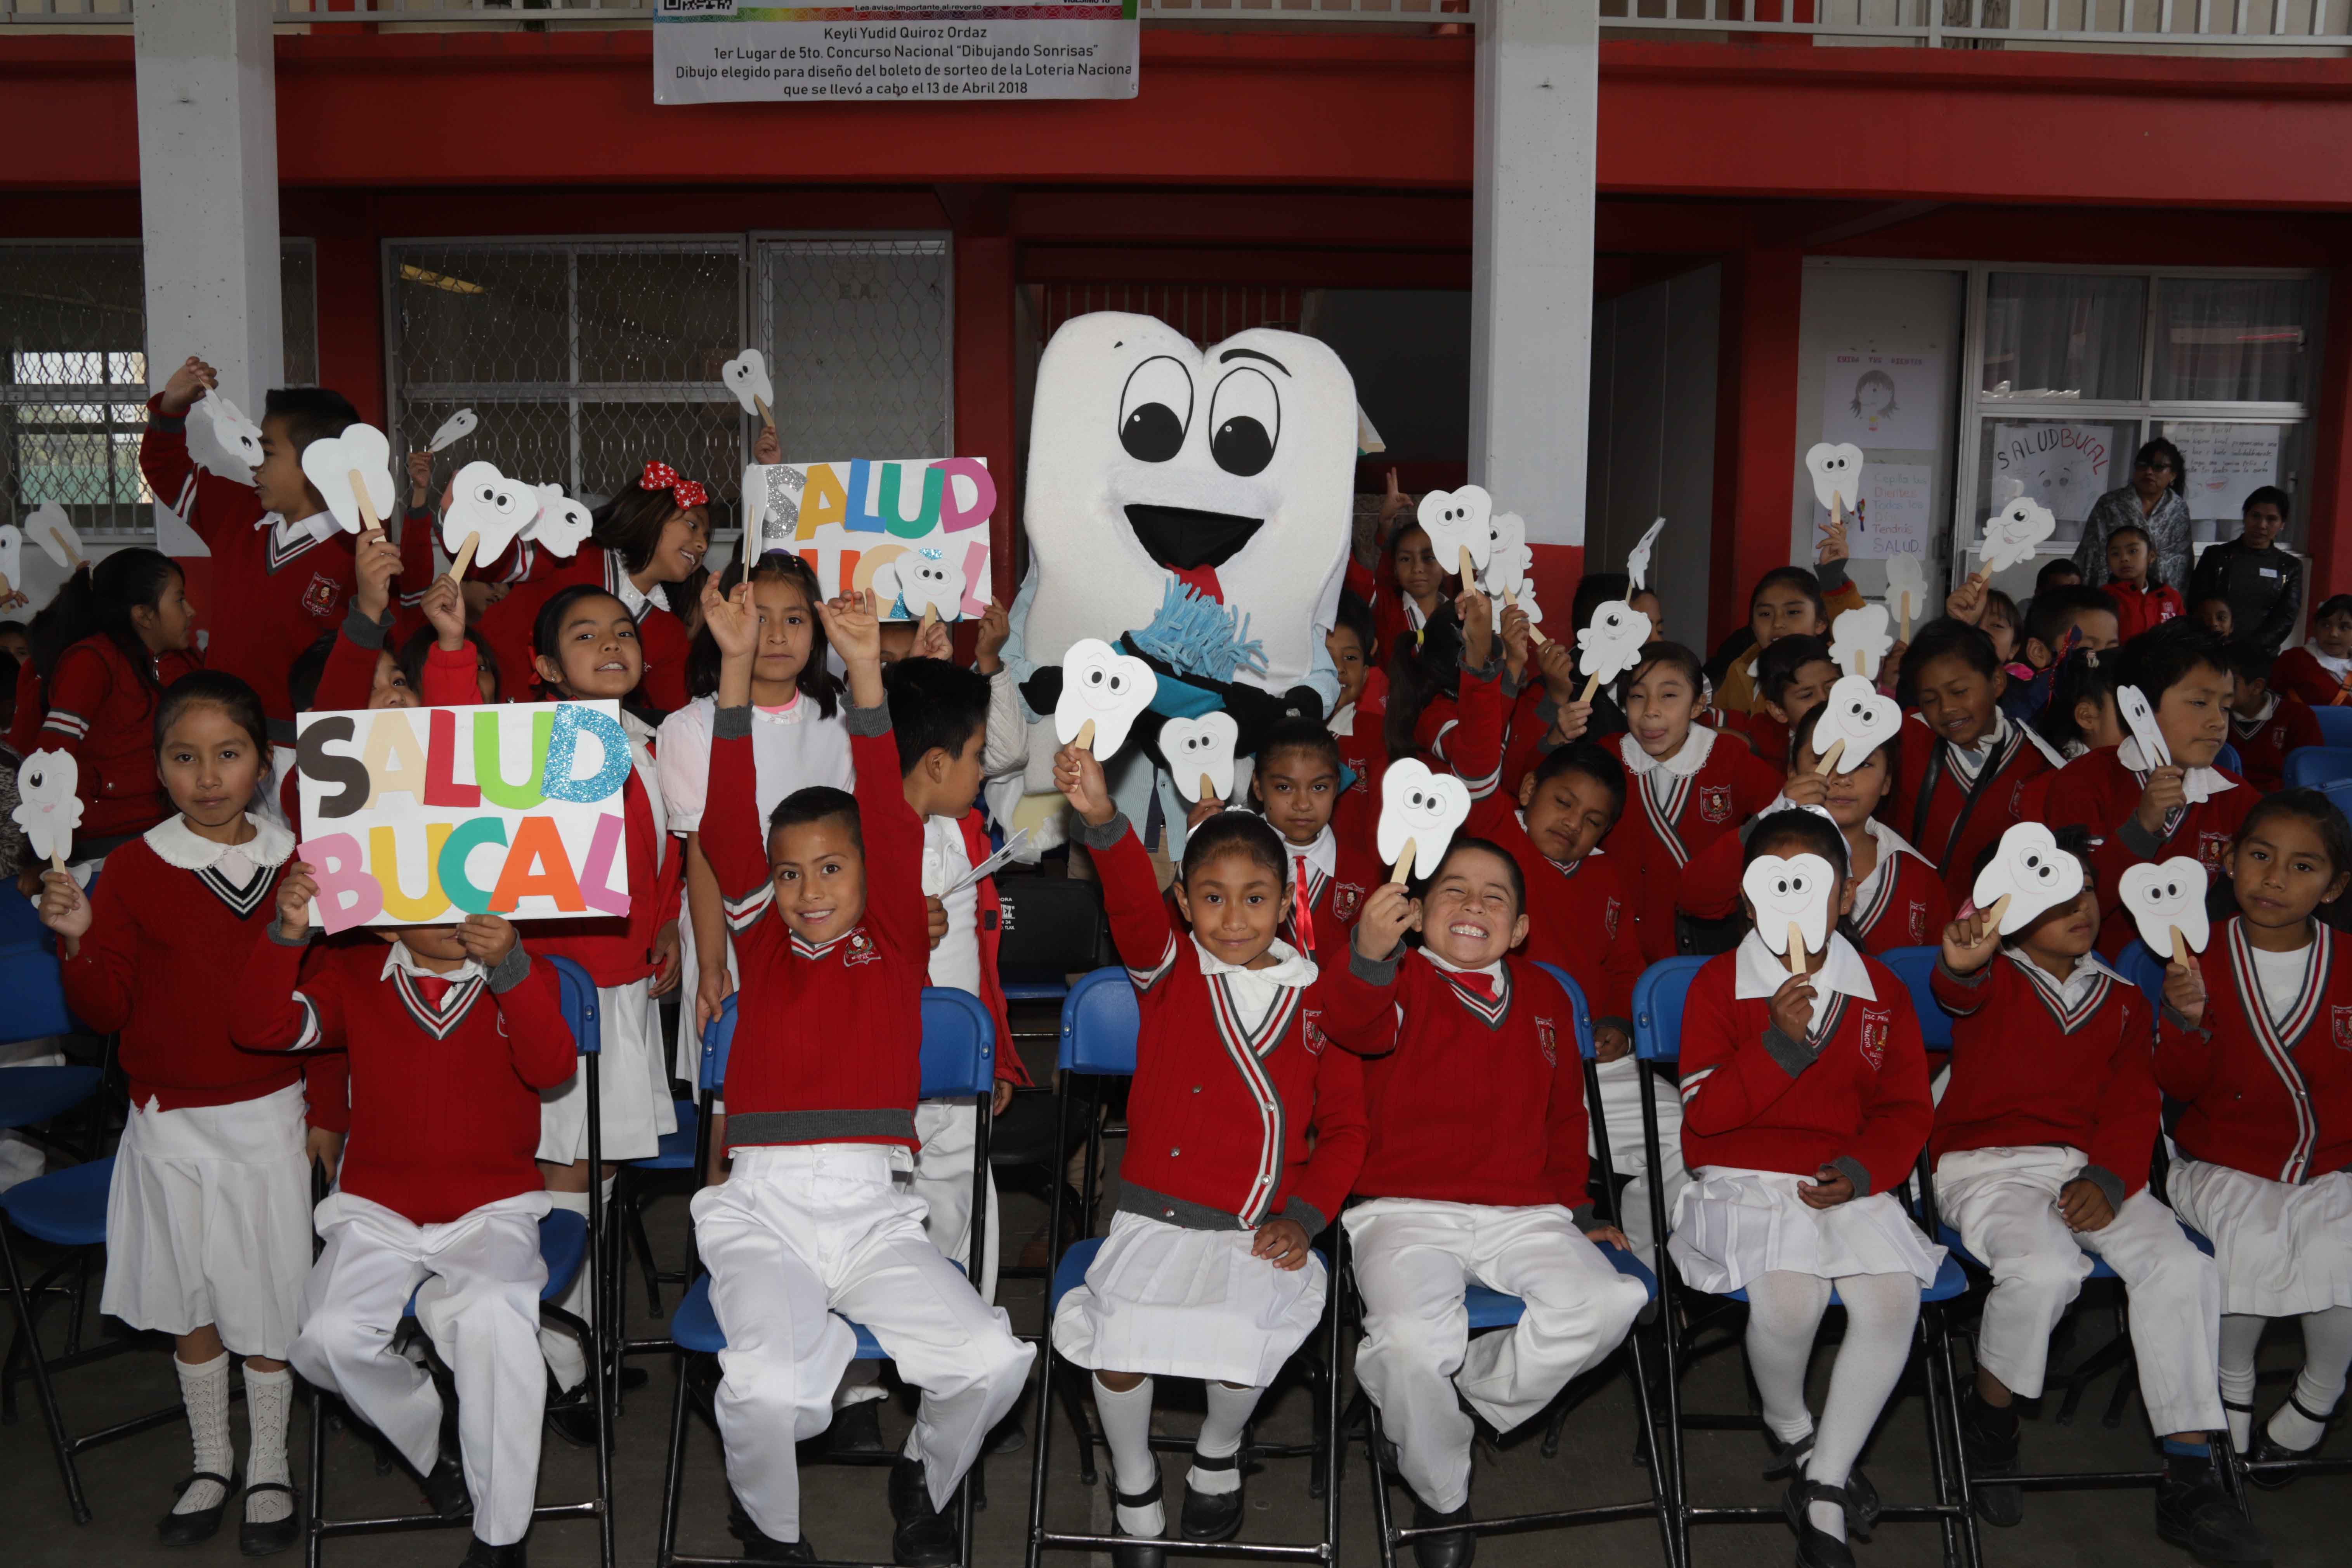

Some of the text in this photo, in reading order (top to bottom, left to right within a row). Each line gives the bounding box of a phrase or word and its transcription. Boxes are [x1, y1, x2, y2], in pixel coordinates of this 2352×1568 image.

[824, 26, 987, 42] Keyli Yudid Quiroz Ordaz
[714, 44, 1098, 62] 1er Lugar de 5to. Concurso Nacional “Dibujando Sonrisas”
[676, 65, 718, 80] Dibujo
[721, 66, 770, 81] elegido
[774, 68, 804, 80] para
[808, 65, 852, 78] diseño
[855, 64, 876, 77] del
[879, 64, 921, 76] boleto
[925, 63, 941, 76] de
[944, 64, 987, 76] sorteo
[991, 63, 1007, 76] de
[1011, 63, 1022, 75] la
[1026, 63, 1074, 76] Loteria
[784, 86, 808, 97] que
[830, 82, 862, 94] llevó
[866, 86, 873, 94] a
[876, 83, 908, 94] cabo
[912, 82, 924, 94] el
[927, 82, 939, 94] 13
[943, 82, 959, 94] de
[962, 82, 995, 94] Abril
[998, 82, 1028, 94] 2018
[1998, 428, 2108, 475] SALUD BUCAL
[763, 457, 997, 541] SALUD
[1875, 487, 1918, 498] Dientes
[1872, 500, 1903, 510] Todos
[1873, 537, 1922, 553] SALUD.
[296, 704, 632, 819] SALUD
[296, 812, 632, 936] BUCAL
[1001, 904, 1015, 918] EZ"
[1864, 1023, 1873, 1048] IGNACIO
